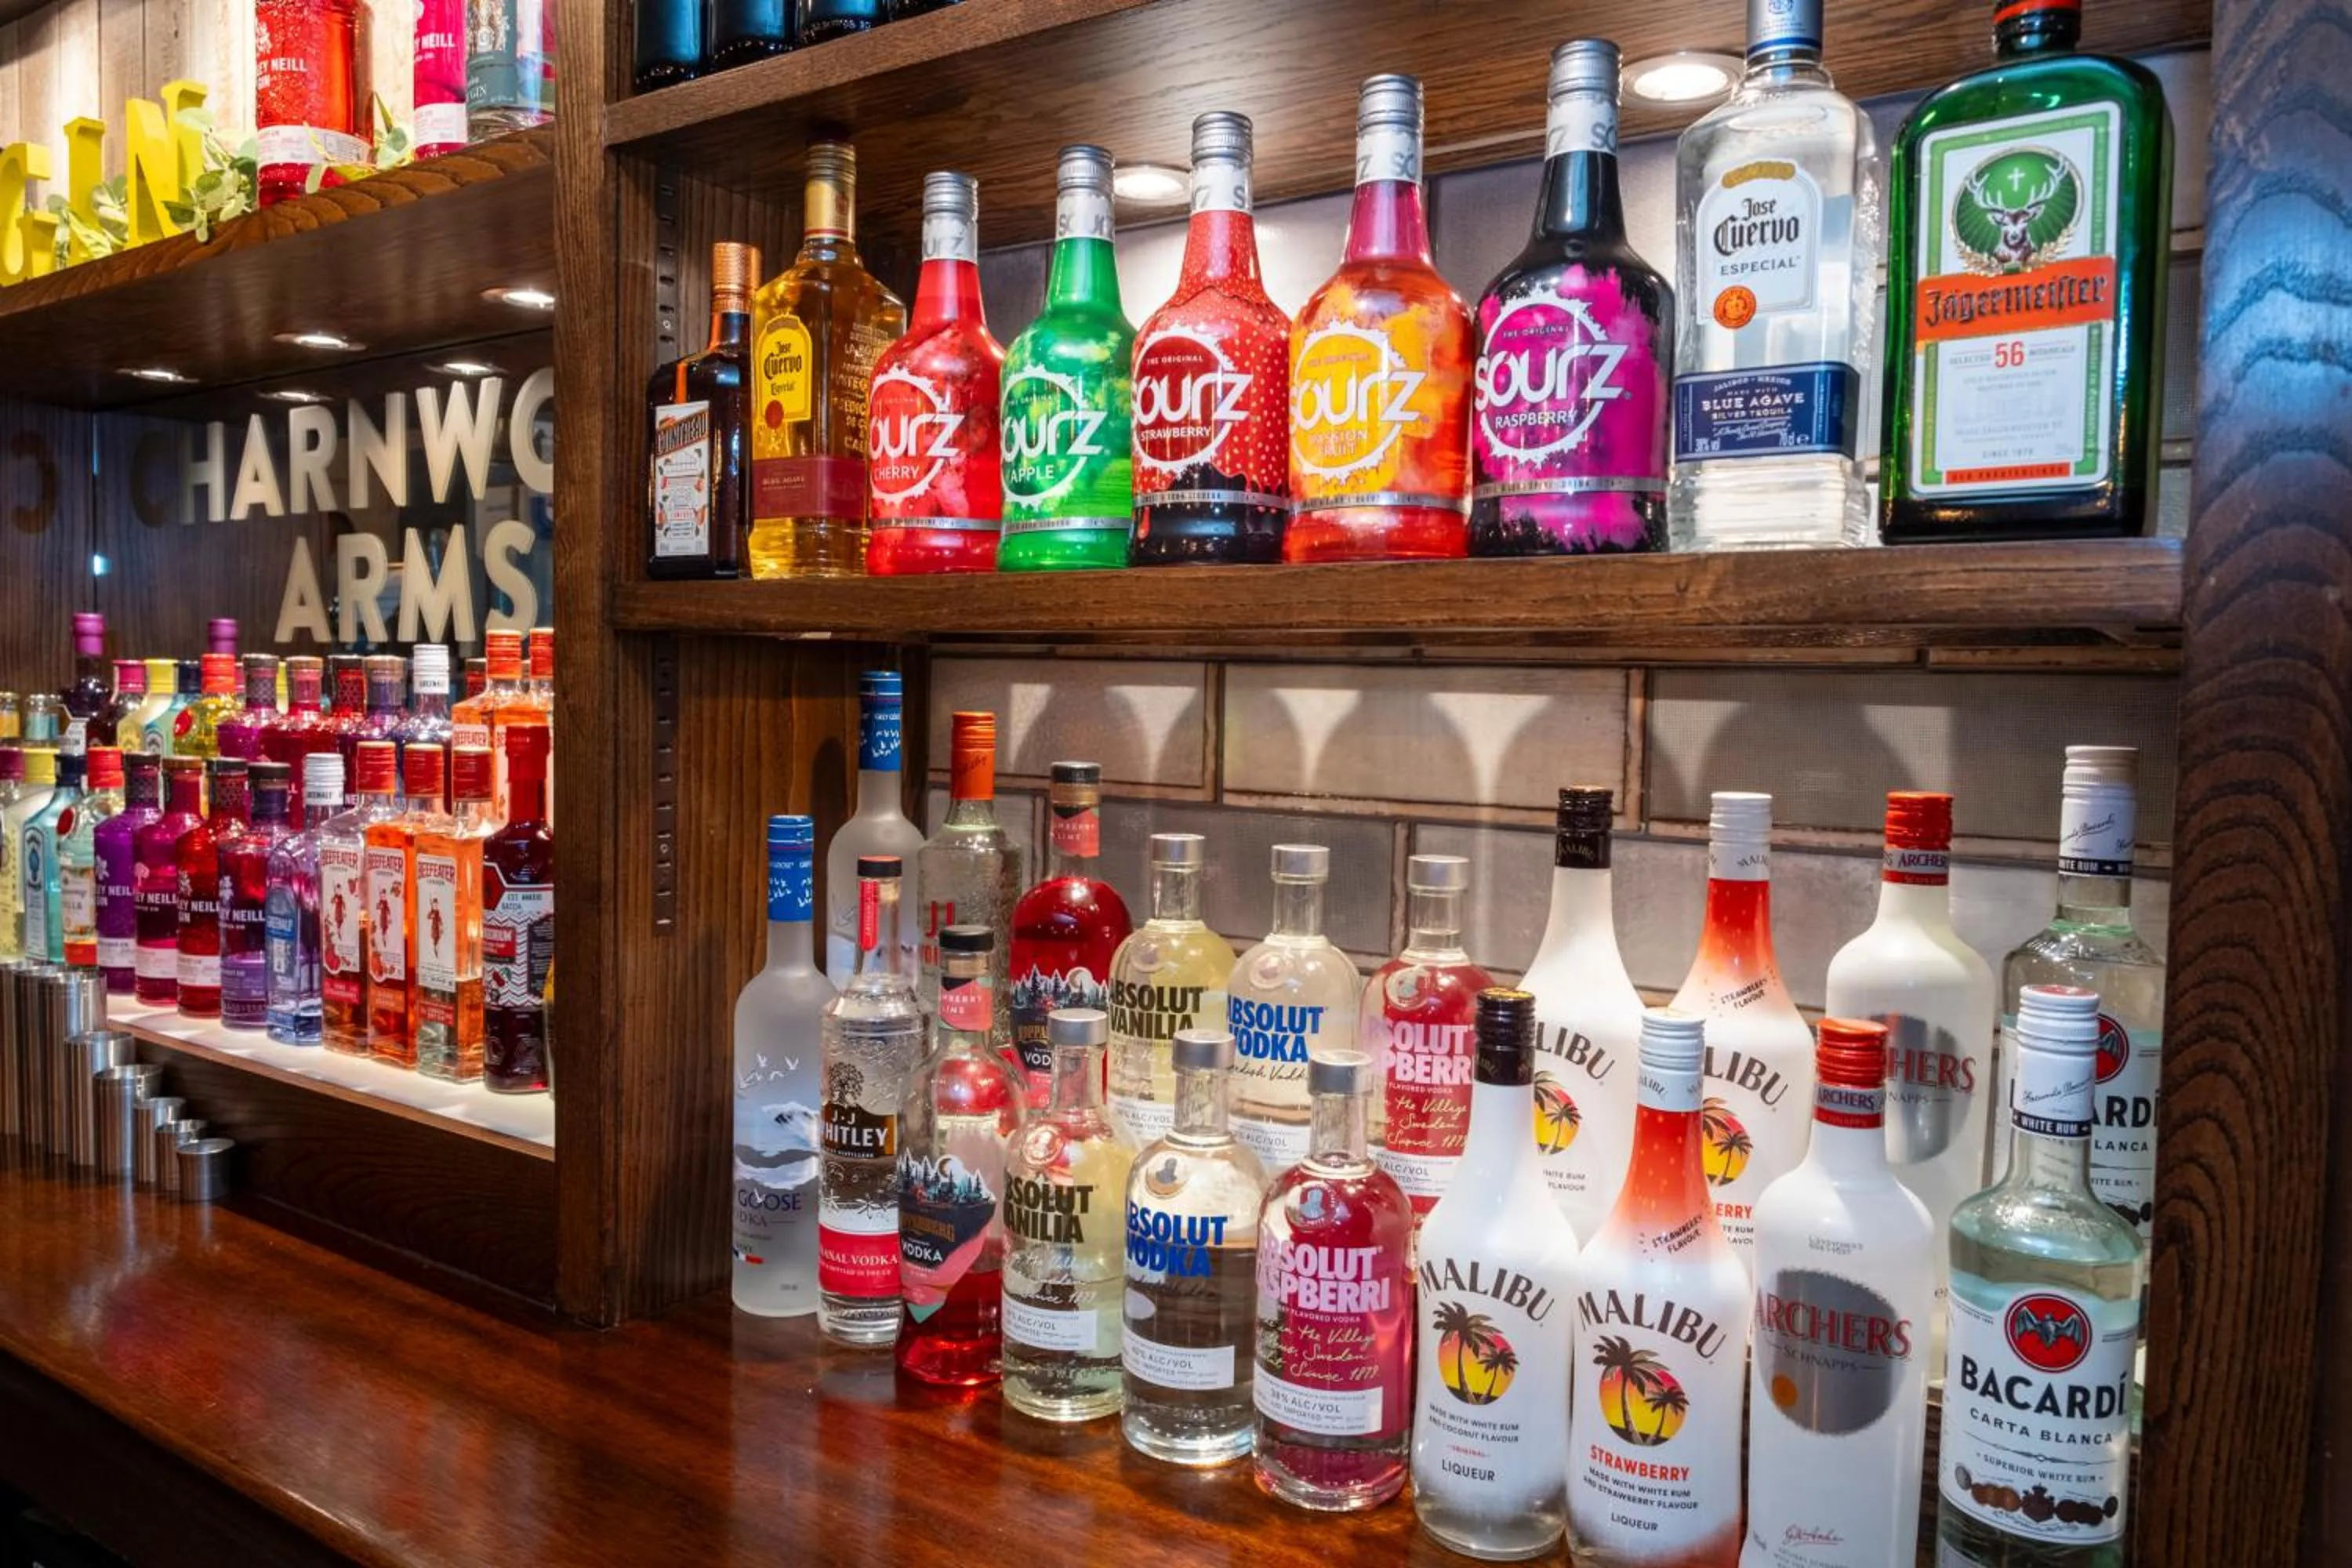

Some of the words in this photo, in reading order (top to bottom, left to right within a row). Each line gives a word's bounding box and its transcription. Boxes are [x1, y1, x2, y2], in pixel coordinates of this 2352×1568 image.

[421, 34, 456, 49] NEILL
[270, 57, 308, 73] NEILL
[1742, 198, 1777, 221] Jose
[1713, 214, 1800, 257] Cuervo
[1719, 257, 1797, 277] ESPECIAL
[1994, 340, 2025, 368] 56
[764, 353, 803, 380] Cuervo
[1701, 397, 1744, 412] BLUE
[1749, 393, 1805, 408] AGAVE
[1711, 411, 1747, 420] SILVER
[1750, 407, 1794, 417] TEQUILA
[1494, 408, 1578, 430] RASPBERRY
[1141, 426, 1211, 441] STRAWBERRY
[874, 465, 920, 481] CHERRY
[1011, 464, 1055, 484] APPLE
[274, 520, 539, 644] ARMS
[417, 862, 456, 885] BEEFEATER
[2078, 860, 2100, 872] RUM
[232, 909, 266, 922] NEILL
[1383, 1018, 1468, 1055] SOLUT
[1024, 1052, 1051, 1065] VOD
[1534, 1021, 1617, 1082] LIBU
[1704, 1045, 1790, 1106] LIBU
[1886, 1047, 1977, 1094] HERS
[1427, 1086, 1454, 1094] VODKA
[1817, 1086, 1875, 1112] ARCHERS
[824, 1121, 888, 1148] HITLEY
[2020, 1116, 2053, 1134] WHITE
[2056, 1123, 2078, 1134] RUM
[2094, 1139, 2149, 1152] LANCA
[738, 1189, 803, 1212] GOOSE
[1006, 1171, 1094, 1214] BSOLUT
[1004, 1203, 1085, 1244] ANILIA
[1127, 1200, 1228, 1247] BSOLUT
[1733, 1225, 1755, 1235] RUM
[851, 1253, 898, 1266] VODKA
[902, 1238, 944, 1262] VODKA
[1127, 1232, 1212, 1279] VODKA
[1265, 1238, 1378, 1280] BSOLUT
[1419, 1257, 1555, 1323] MALIBU
[1290, 1309, 1331, 1323] FLAVORED
[1333, 1316, 1361, 1324] VODKA
[1577, 1289, 1728, 1360] MALIBU
[1755, 1287, 1914, 1360] ARCHERS
[1298, 1323, 1322, 1342] the
[1147, 1353, 1193, 1370] ALC/VOL
[1301, 1343, 1368, 1363] Sweden
[1783, 1344, 1860, 1371] SCHNAPPS
[1960, 1354, 2127, 1420] BACARDÍ
[1290, 1396, 1341, 1414] ALC/VOL
[1442, 1421, 1479, 1440] COCONUT
[1480, 1430, 1519, 1444] FLAVOUR
[1448, 1411, 1469, 1425] WITH
[1471, 1417, 1498, 1431] WHITE
[1500, 1423, 1520, 1432] RUM
[1969, 1406, 2031, 1438] CARTA
[2039, 1429, 2114, 1446] BLANCA
[1441, 1458, 1496, 1483] LIQUEUR
[1589, 1444, 1690, 1483] STRAWBERRY
[1983, 1453, 2035, 1478] SUPERIOR
[2037, 1469, 2074, 1483] WHITE
[2076, 1474, 2098, 1484] RUM
[1582, 1475, 1598, 1490] AND
[1598, 1484, 1655, 1507] STRAWBERRY
[1657, 1500, 1700, 1512] FLAVOUR
[1588, 1466, 1610, 1483] MADE
[1611, 1476, 1635, 1491] WITH
[1637, 1484, 1668, 1498] WHITE
[1670, 1490, 1692, 1498] RUM
[1610, 1512, 1659, 1533] LIQUEUR
